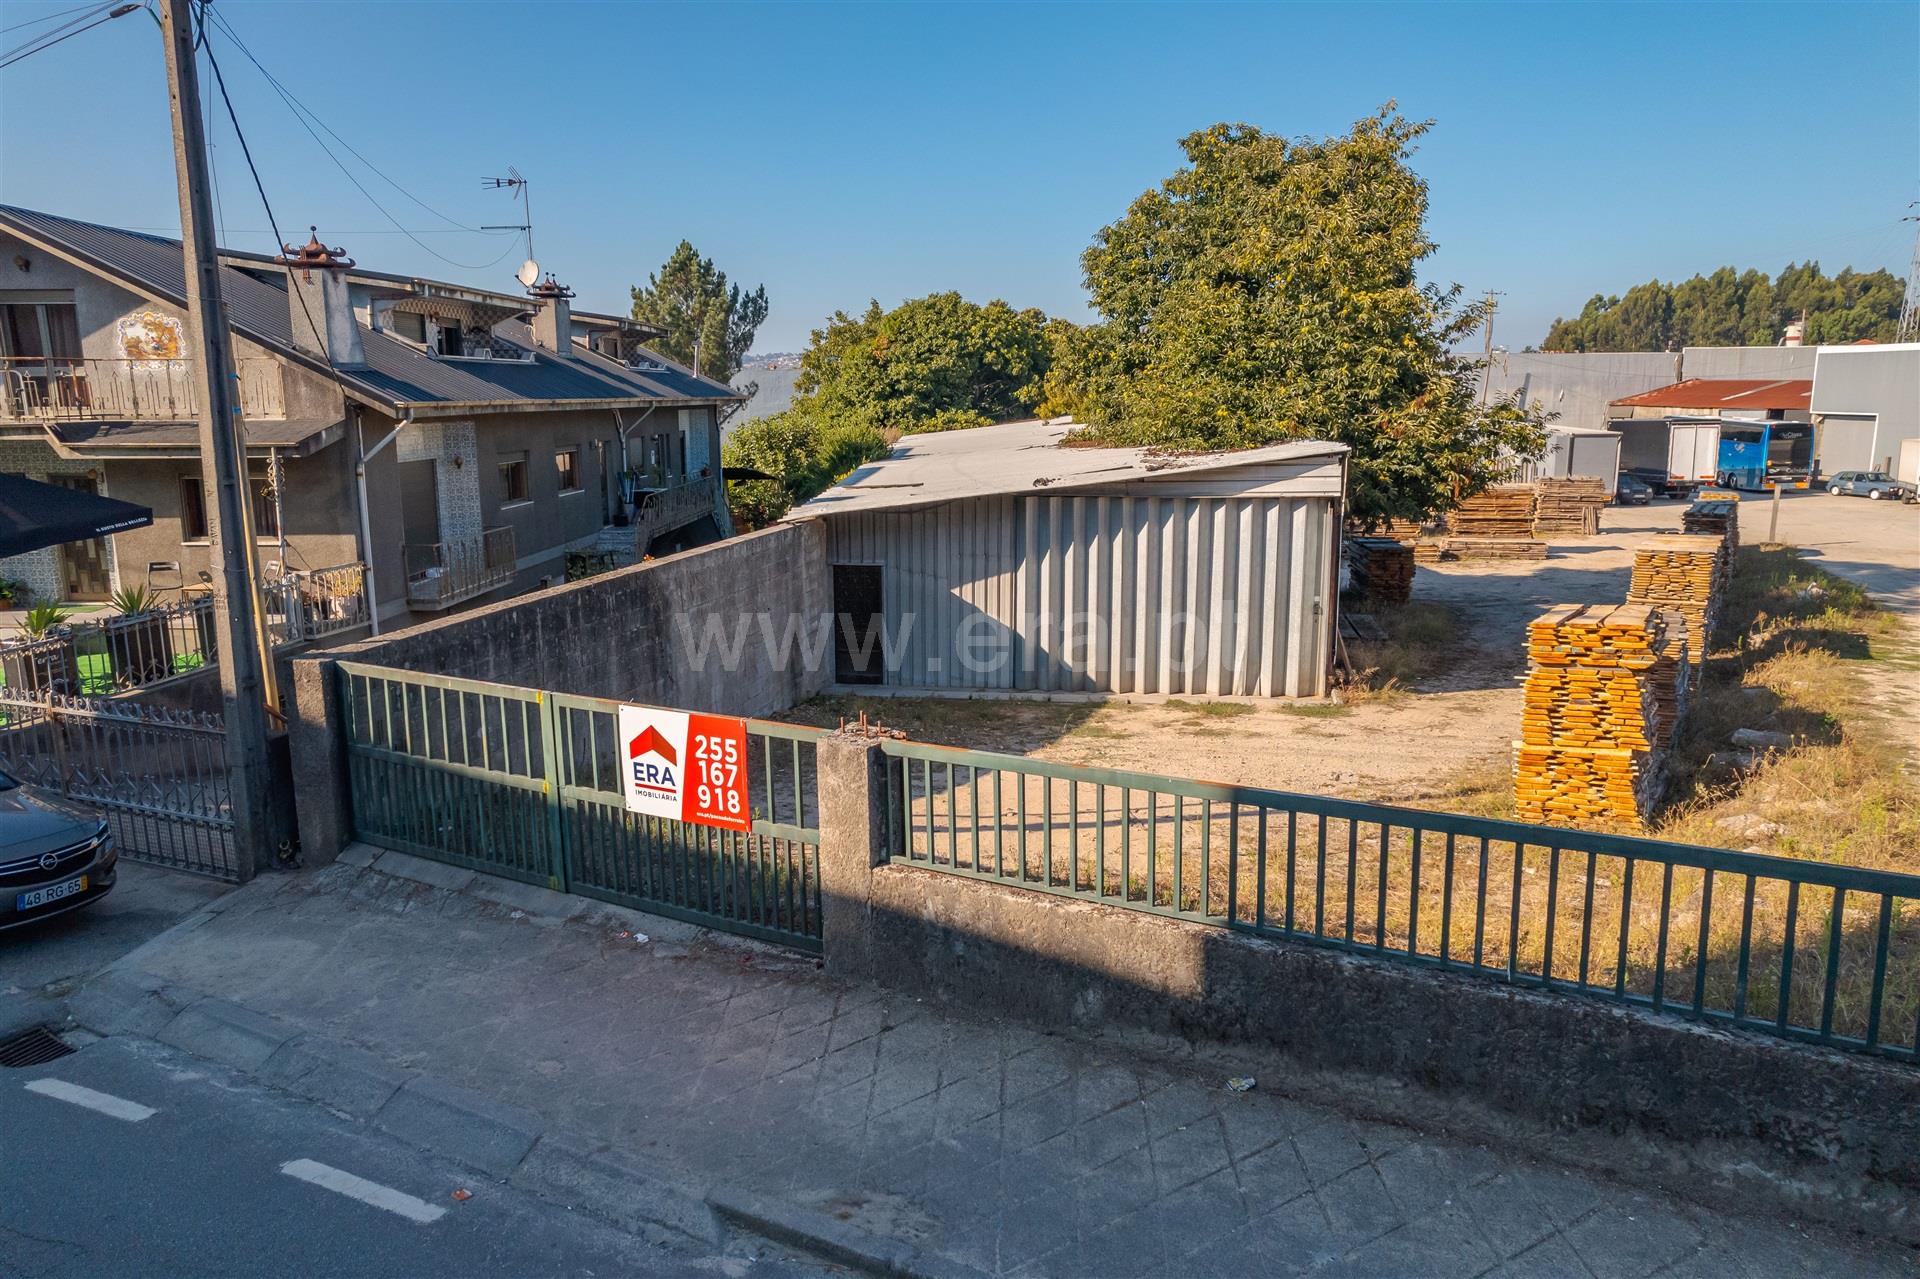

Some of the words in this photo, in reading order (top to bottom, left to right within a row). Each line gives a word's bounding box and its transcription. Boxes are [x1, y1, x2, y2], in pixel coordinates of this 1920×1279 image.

[694, 734, 737, 763] 255
[633, 761, 676, 786] ERA
[698, 760, 738, 788] 167
[635, 789, 677, 802] IMOBILIÁRIA
[697, 784, 741, 814] 918
